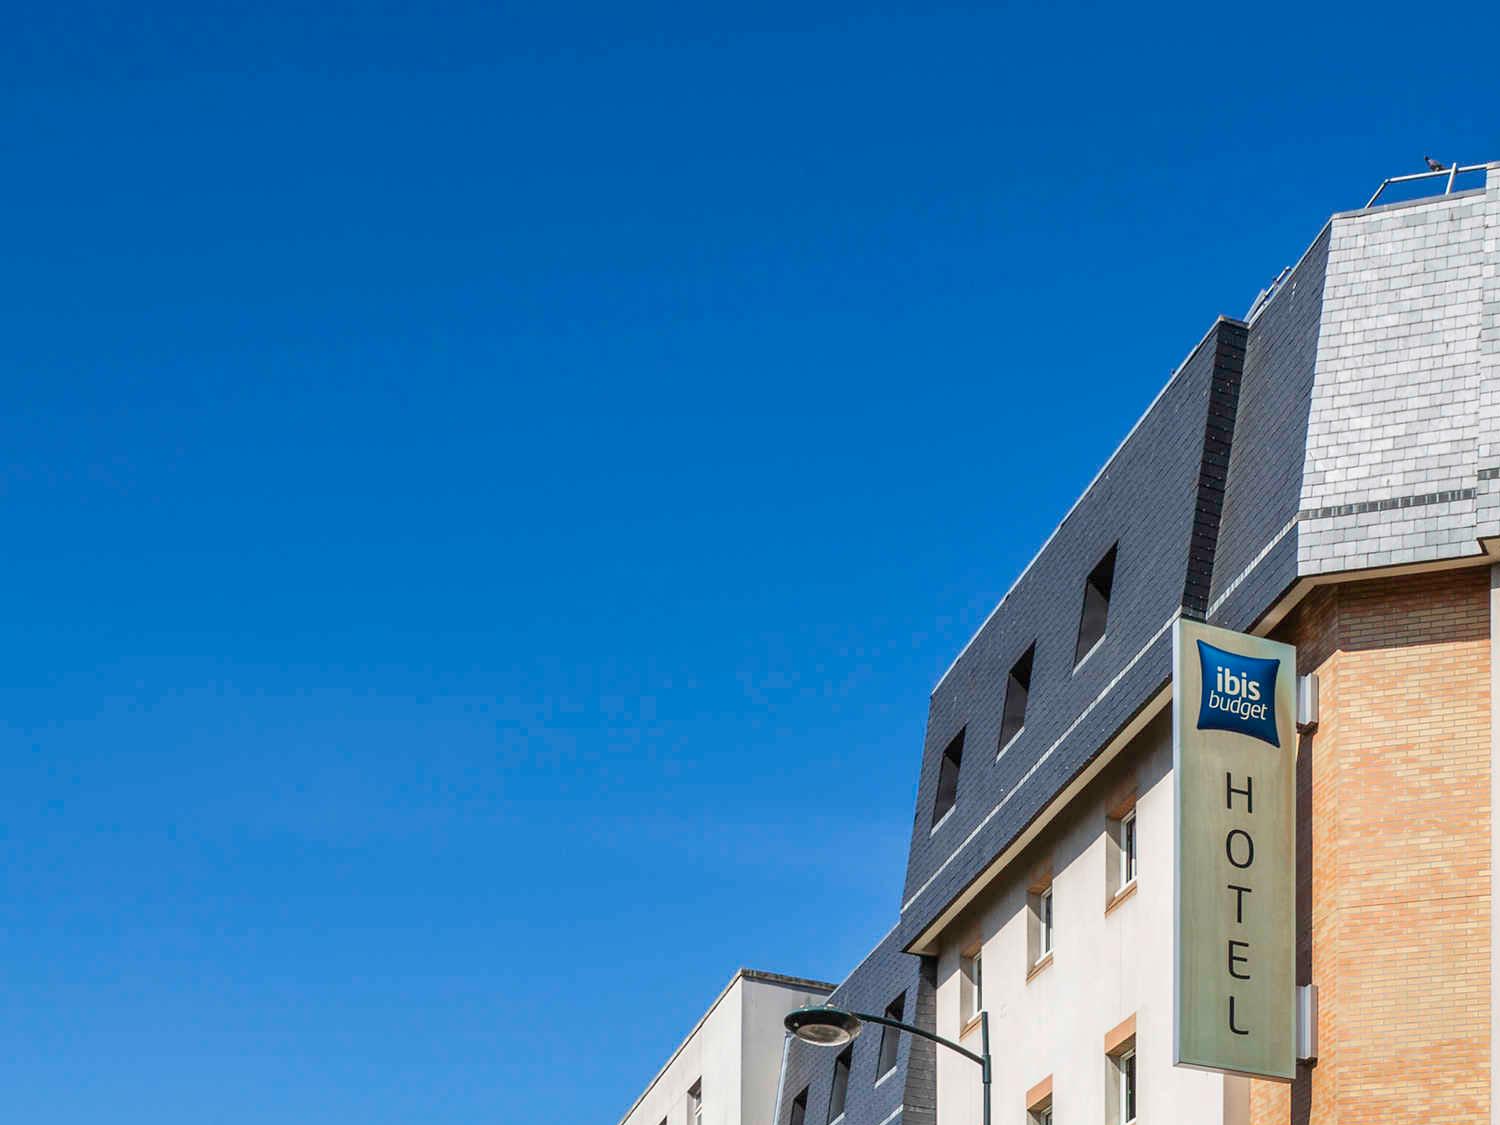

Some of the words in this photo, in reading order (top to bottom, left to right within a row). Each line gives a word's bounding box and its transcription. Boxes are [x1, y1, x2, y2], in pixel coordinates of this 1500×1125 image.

[1217, 666, 1261, 701] ibis
[1208, 690, 1268, 721] budget
[1225, 771, 1255, 1036] HOTEL
